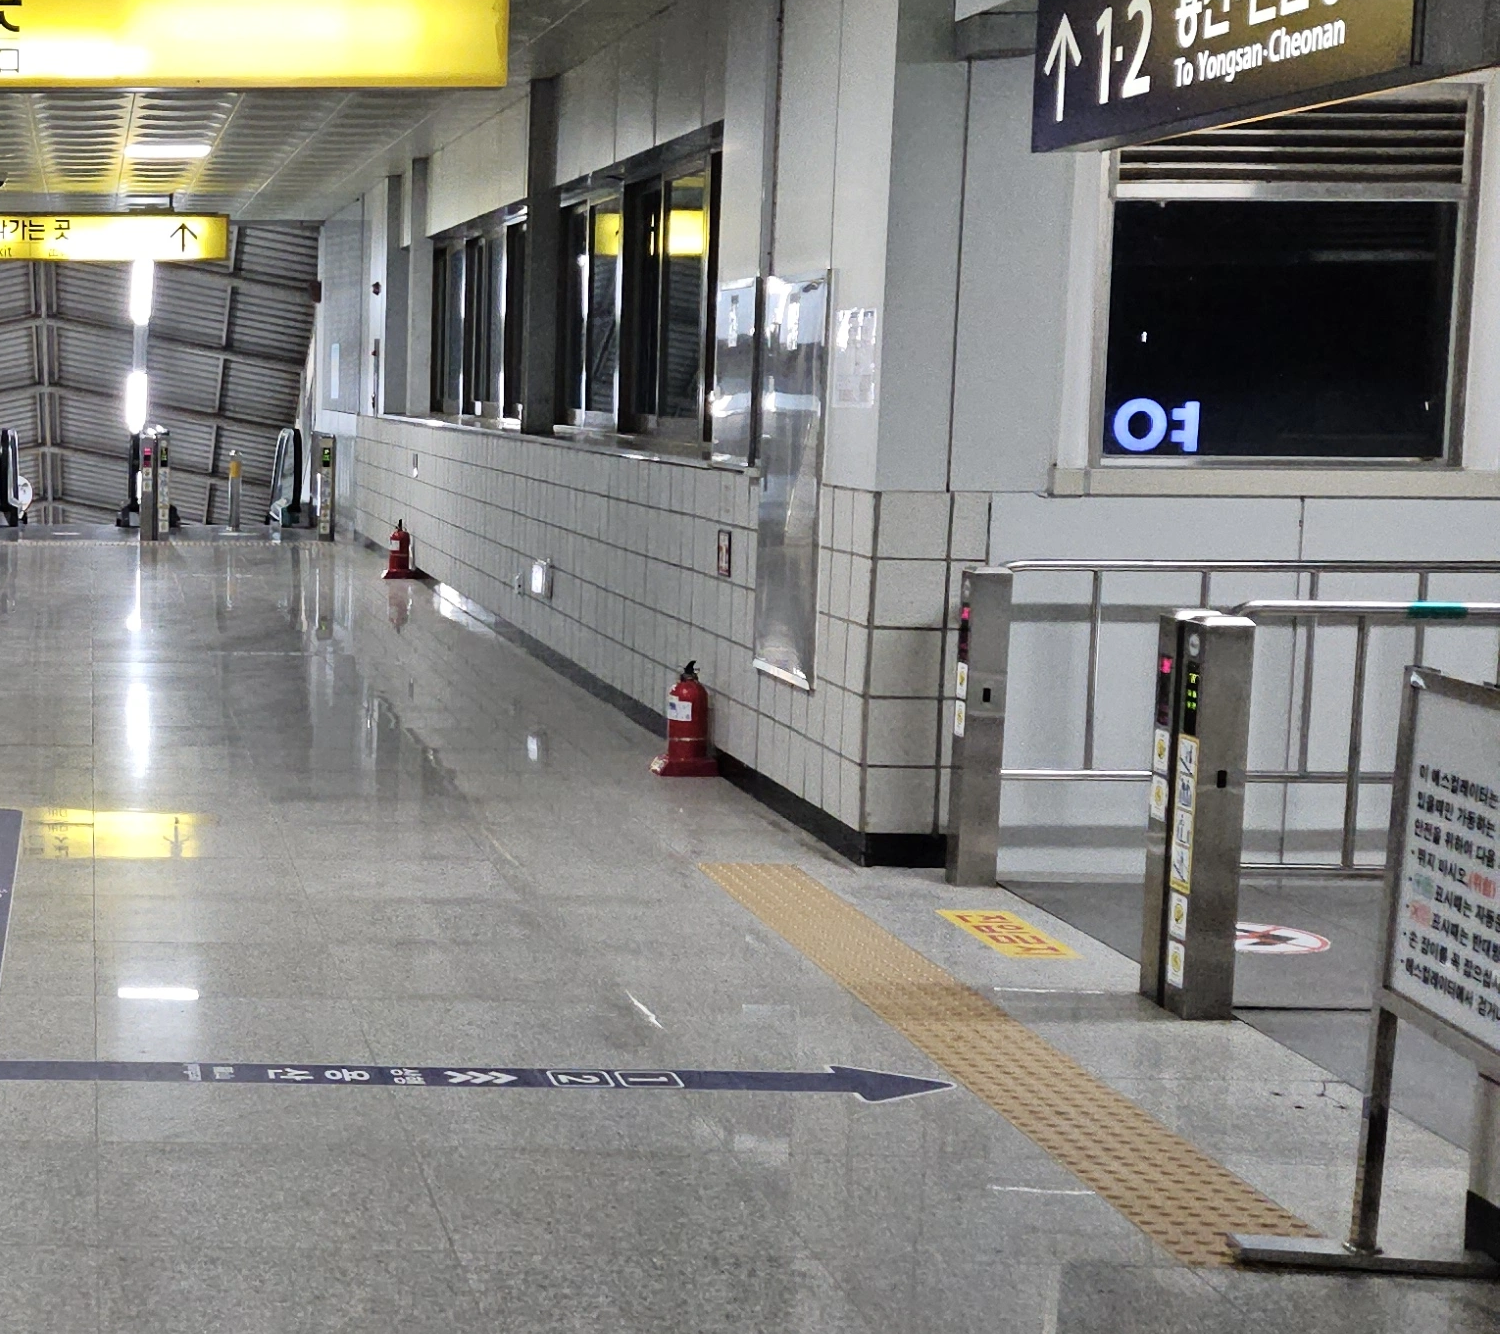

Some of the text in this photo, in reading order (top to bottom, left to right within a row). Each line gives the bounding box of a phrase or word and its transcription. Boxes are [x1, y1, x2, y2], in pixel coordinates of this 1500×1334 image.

[1174, 56, 1194, 88] To
[53, 219, 71, 241] 곳
[1475, 845, 1496, 869] 다음
[266, 1067, 370, 1082] 용산
[557, 1074, 600, 1084] 2
